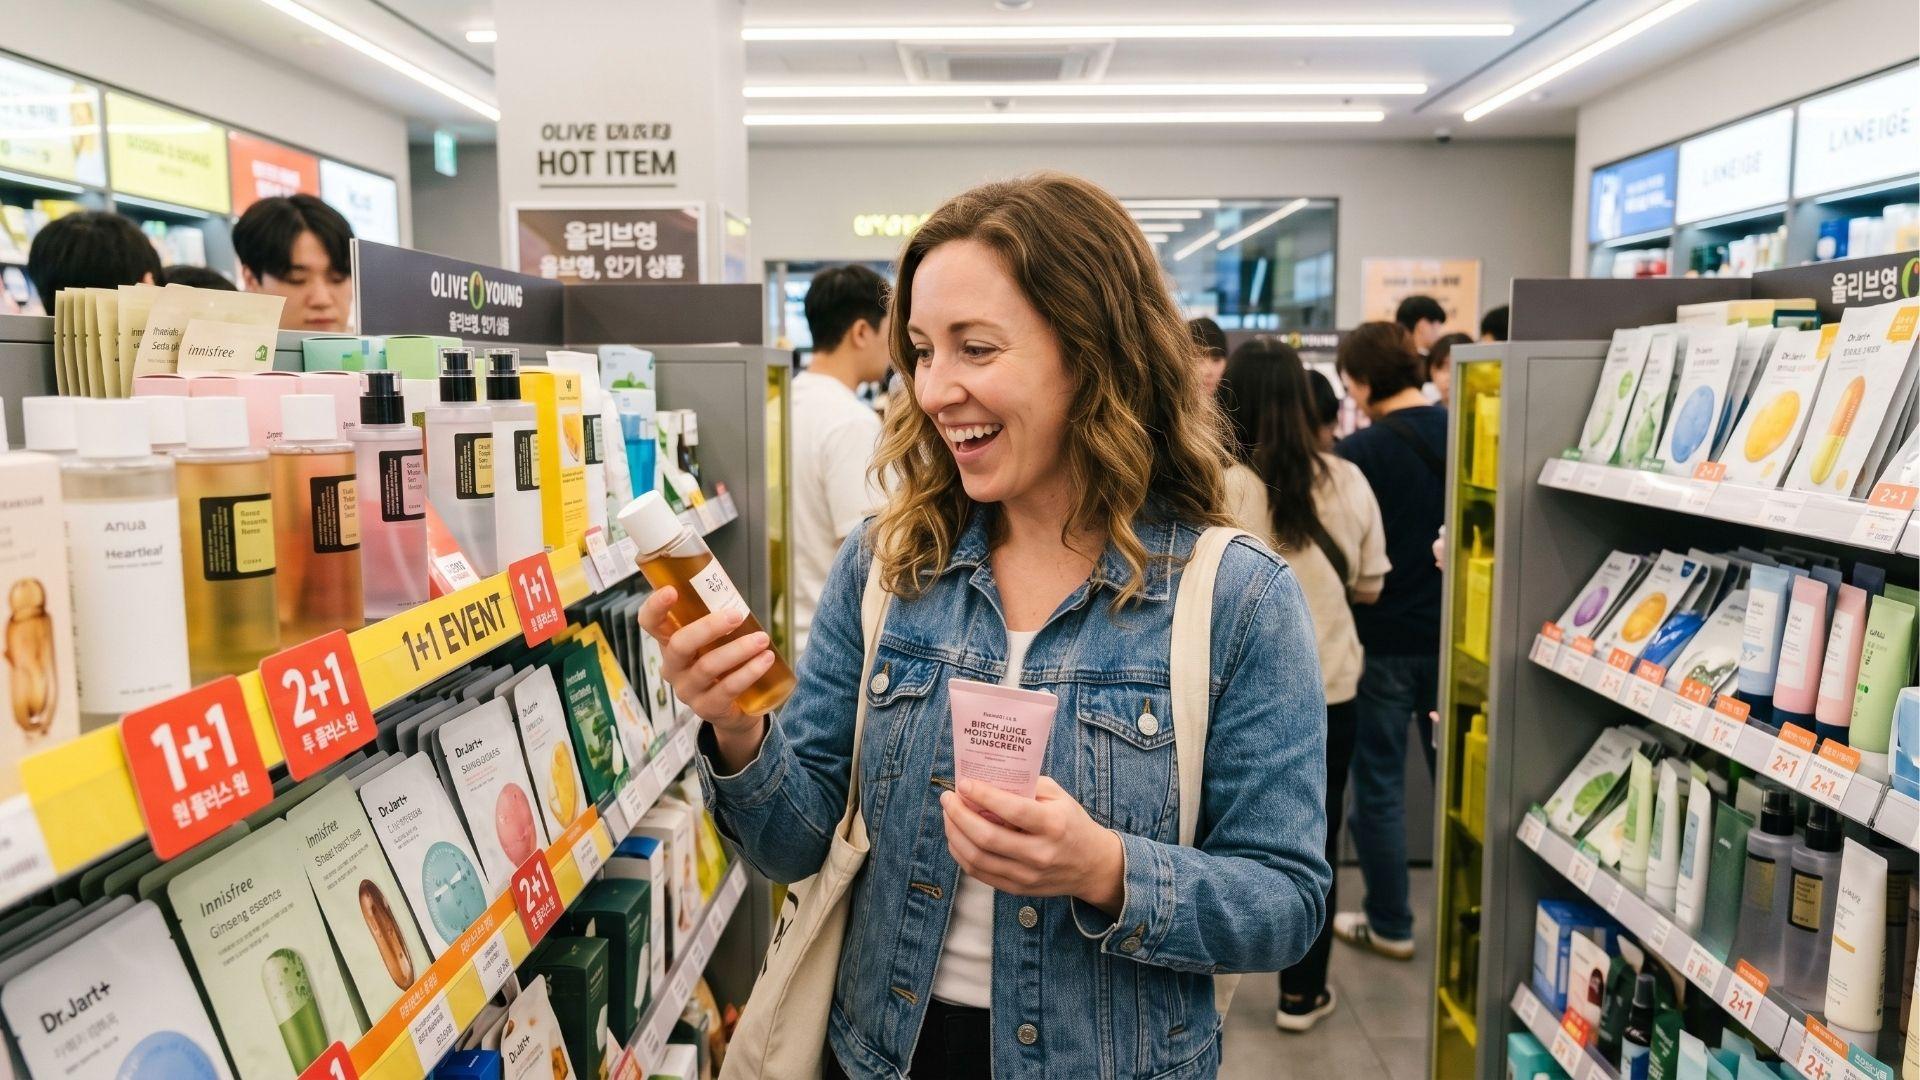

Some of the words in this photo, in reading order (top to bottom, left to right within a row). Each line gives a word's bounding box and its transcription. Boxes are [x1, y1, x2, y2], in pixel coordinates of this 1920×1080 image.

[541, 123, 597, 141] OLIVE
[537, 150, 595, 175] HOT
[606, 150, 676, 175] ITEM
[563, 220, 658, 251] 올리브영
[604, 255, 643, 279] 인기
[431, 271, 469, 301] OLIVE
[485, 280, 524, 309] YOUNG
[1830, 265, 1898, 305] 올리브영
[187, 344, 236, 359] innisfree
[1879, 488, 1908, 505] 2+1
[104, 520, 147, 532] Anua
[519, 565, 552, 612] 1+1
[402, 622, 442, 672] 1+1
[439, 592, 506, 655] EVENT
[281, 652, 351, 729] 2+1
[964, 728, 1032, 745] MOISTURIZING
[971, 720, 999, 731] BIRCH
[1000, 725, 1027, 736] JUICE
[150, 702, 240, 793] 1+1
[301, 733, 316, 756] 투
[970, 737, 1025, 753] SUNSCREEN
[1772, 755, 1799, 778] 2+1
[1810, 774, 1836, 797] 2+1
[171, 802, 194, 830] 원
[189, 786, 235, 824] 플러스
[232, 770, 252, 798] 원
[519, 860, 550, 914] 2+1
[209, 910, 250, 939] Ginseng
[249, 889, 282, 915] essence
[40, 981, 111, 1034] Dr.Jart+
[1728, 990, 1753, 1020] 2+1
